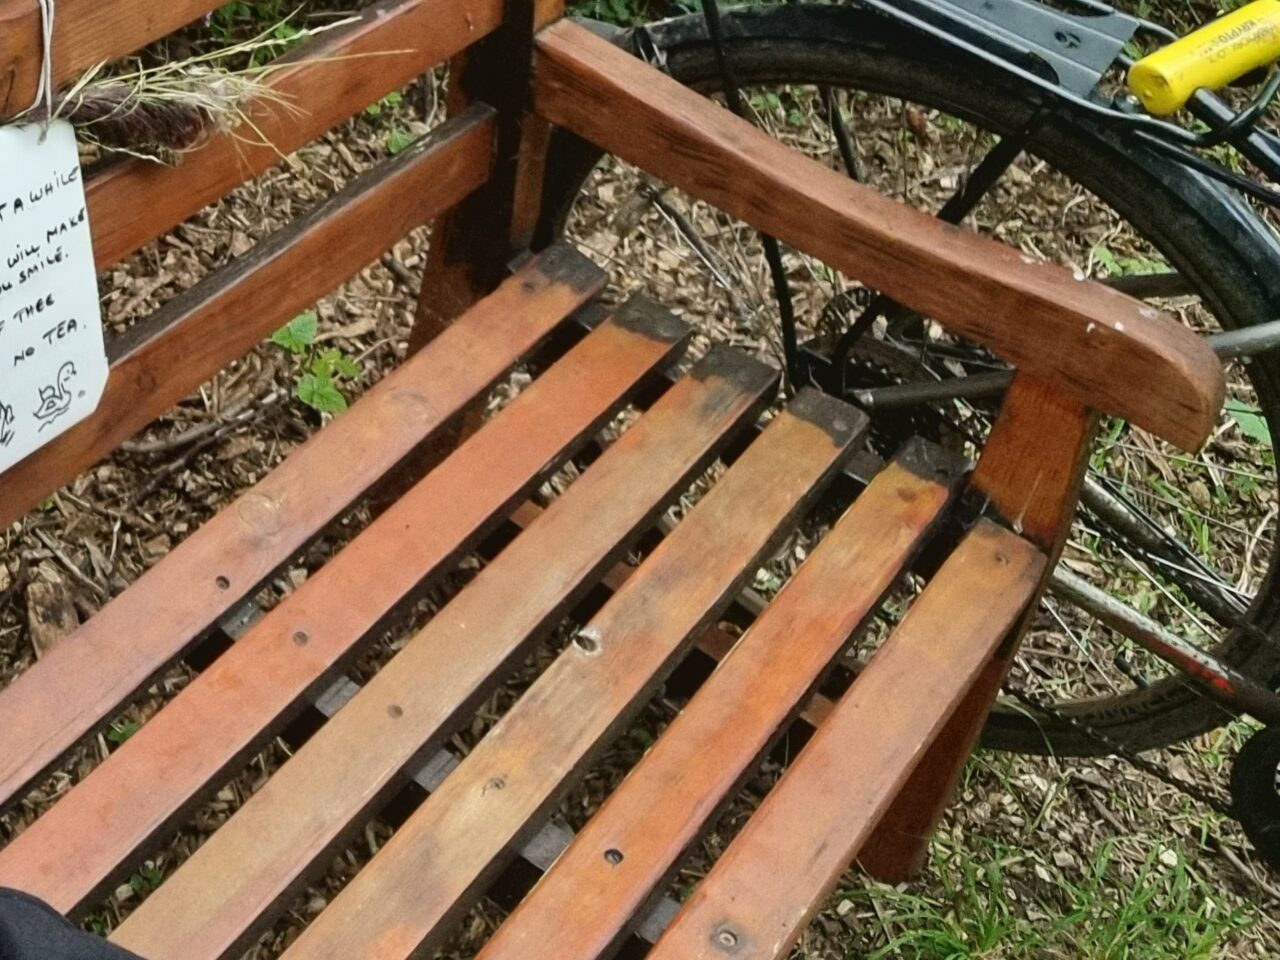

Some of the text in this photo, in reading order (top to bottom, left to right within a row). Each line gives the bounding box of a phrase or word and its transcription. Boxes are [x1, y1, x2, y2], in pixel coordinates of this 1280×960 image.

[13, 197, 24, 214] A
[29, 165, 79, 203] WHILE
[46, 206, 85, 244] MAKE
[12, 293, 55, 323] THEE
[13, 346, 36, 367] NO
